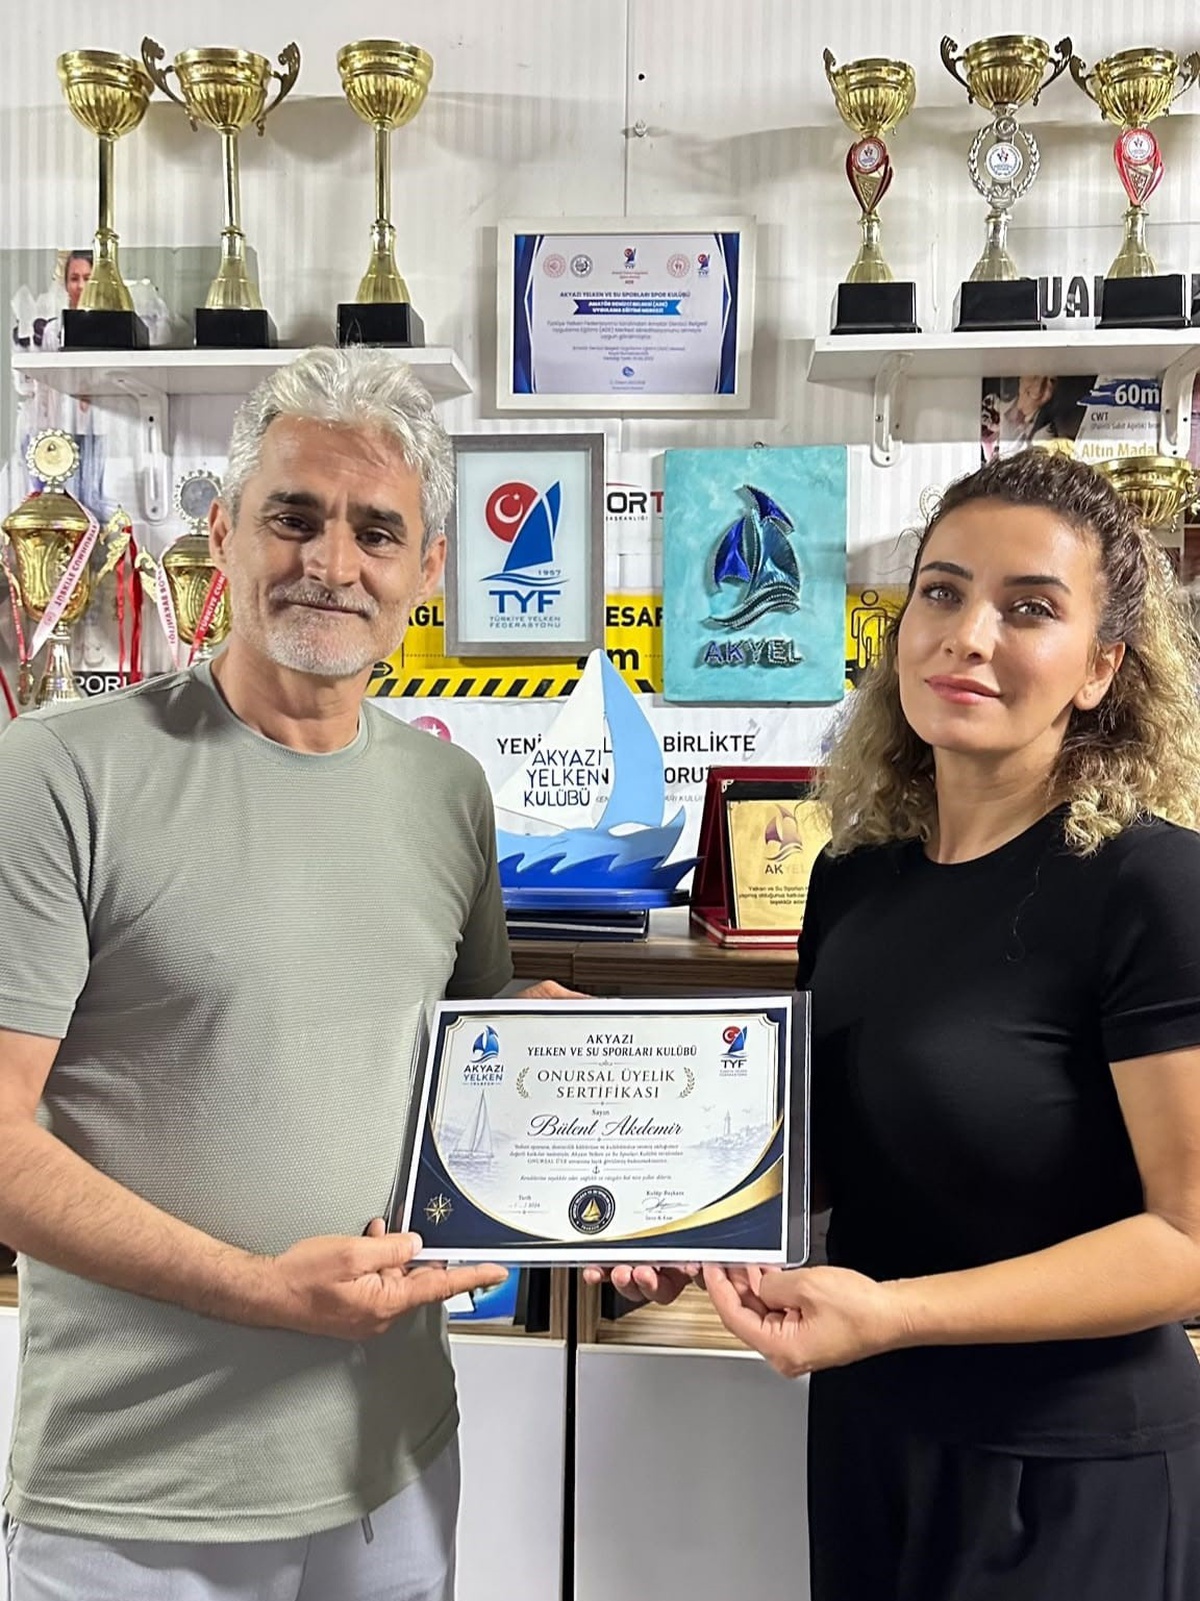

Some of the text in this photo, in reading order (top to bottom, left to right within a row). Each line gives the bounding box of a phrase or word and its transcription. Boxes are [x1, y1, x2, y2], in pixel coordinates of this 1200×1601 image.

[1091, 412, 1109, 421] CWT
[489, 590, 561, 613] TYF
[704, 638, 803, 664] AKYEL
[663, 732, 755, 752] BİRLİKTE
[532, 749, 601, 766] AKYAZI
[526, 769, 599, 788] YELKEN
[524, 788, 590, 807] KULÜBÜ
[586, 1034, 633, 1044] AKYAZI
[527, 1045, 697, 1056] YELKEN VE SU SPORLARI KULÜBÜ
[463, 1064, 504, 1073] AKYAZI
[720, 1059, 747, 1068] TYF
[463, 1073, 503, 1081] YELKEN
[537, 1067, 675, 1082] ONURSAL ÜYELİK
[556, 1085, 660, 1099] SERTİFİKASI
[527, 1114, 683, 1137] Bülent Akdemir
